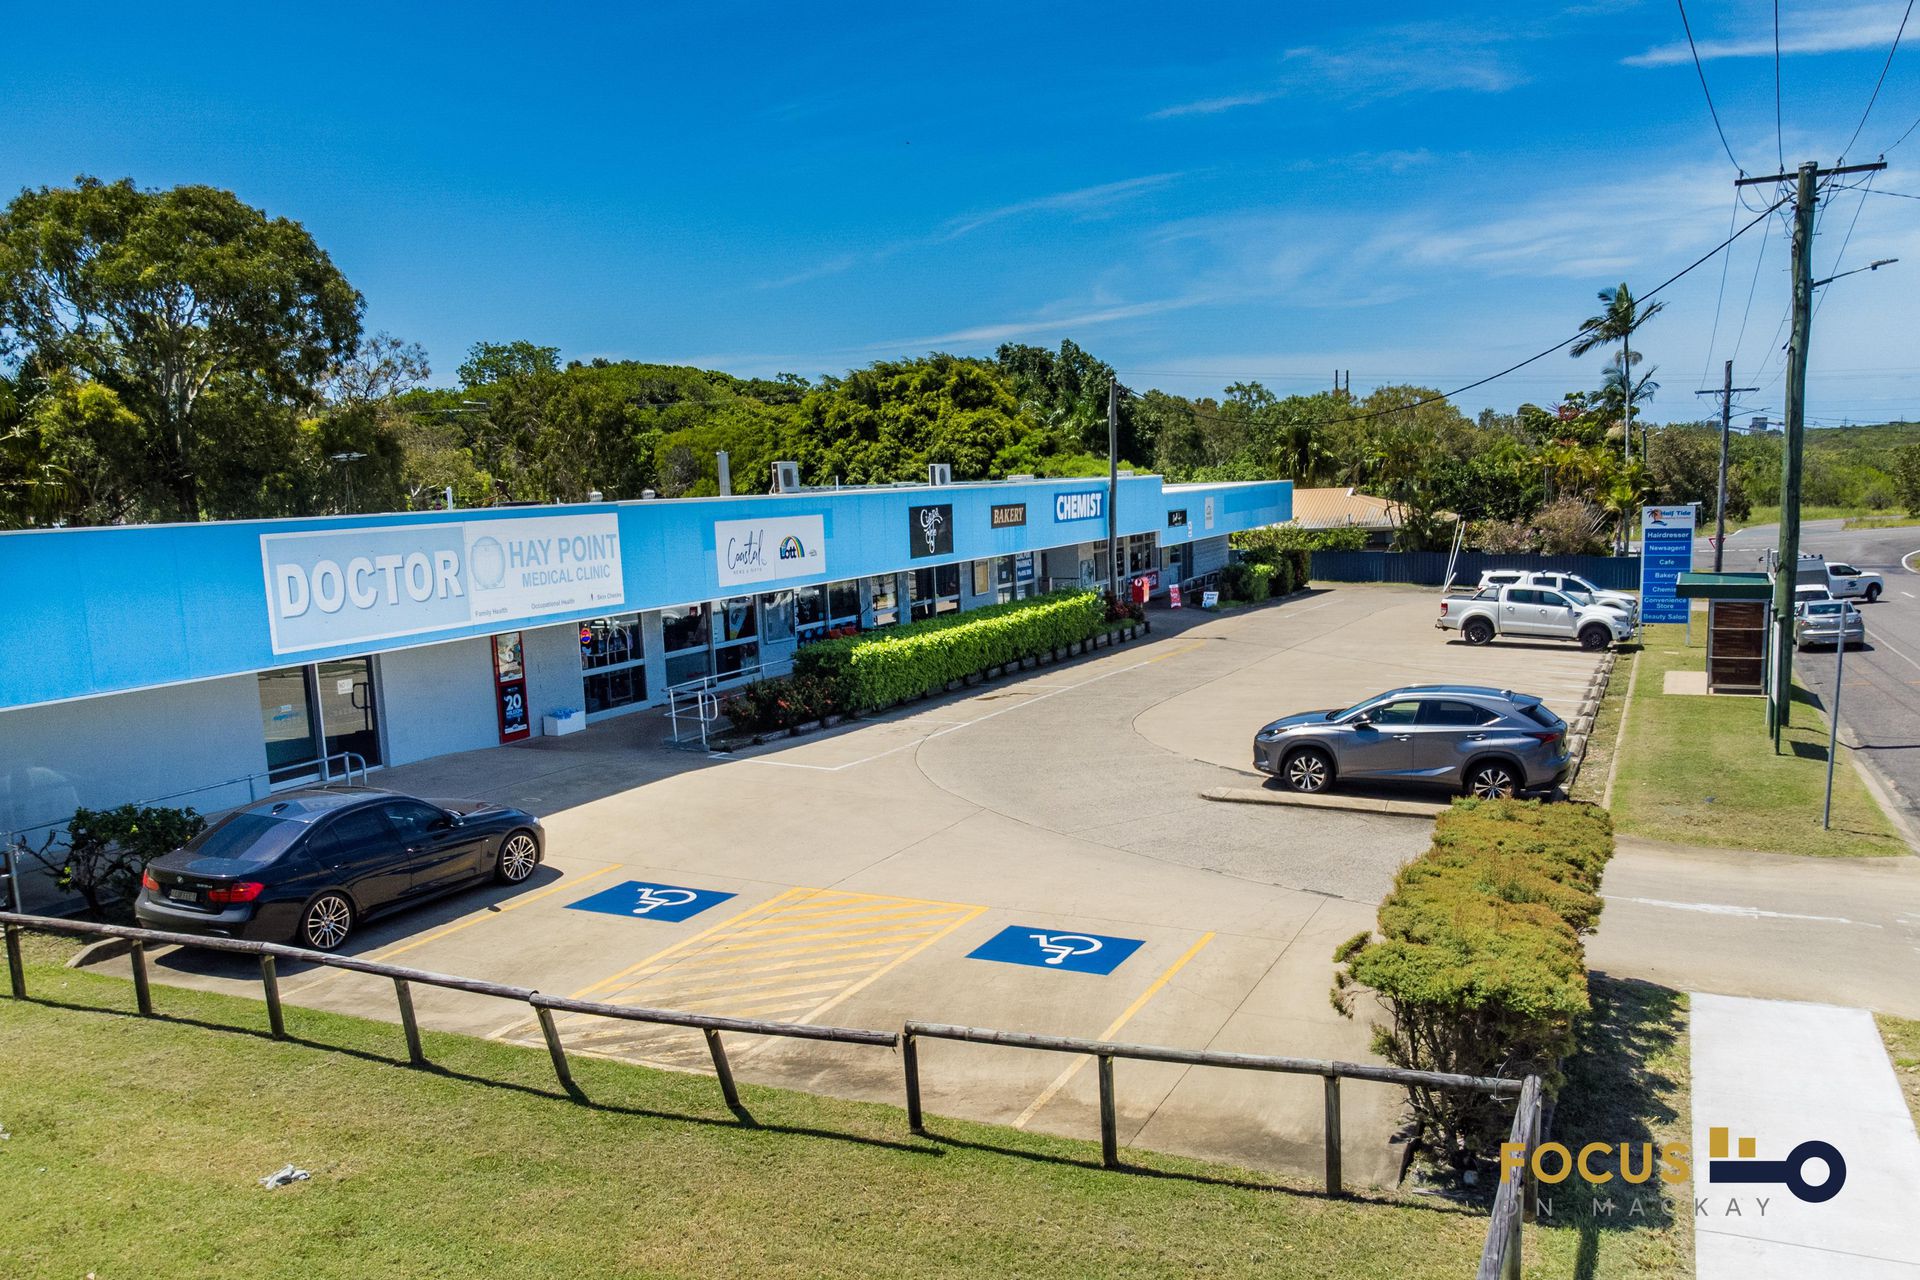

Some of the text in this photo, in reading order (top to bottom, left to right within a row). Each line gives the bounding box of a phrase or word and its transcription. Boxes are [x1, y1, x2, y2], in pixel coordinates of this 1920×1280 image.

[993, 506, 1024, 525] BAKERY
[1056, 493, 1102, 521] CHEMIST
[508, 533, 617, 568] HAY POINT
[727, 529, 767, 570] Coastal
[779, 545, 797, 560] Lott
[275, 549, 465, 619] DOCTOR
[521, 564, 611, 589] MEDICAL CLINIC
[1655, 572, 1678, 580] Bakery
[474, 606, 508, 619] Family Health
[530, 599, 560, 611] Occupational
